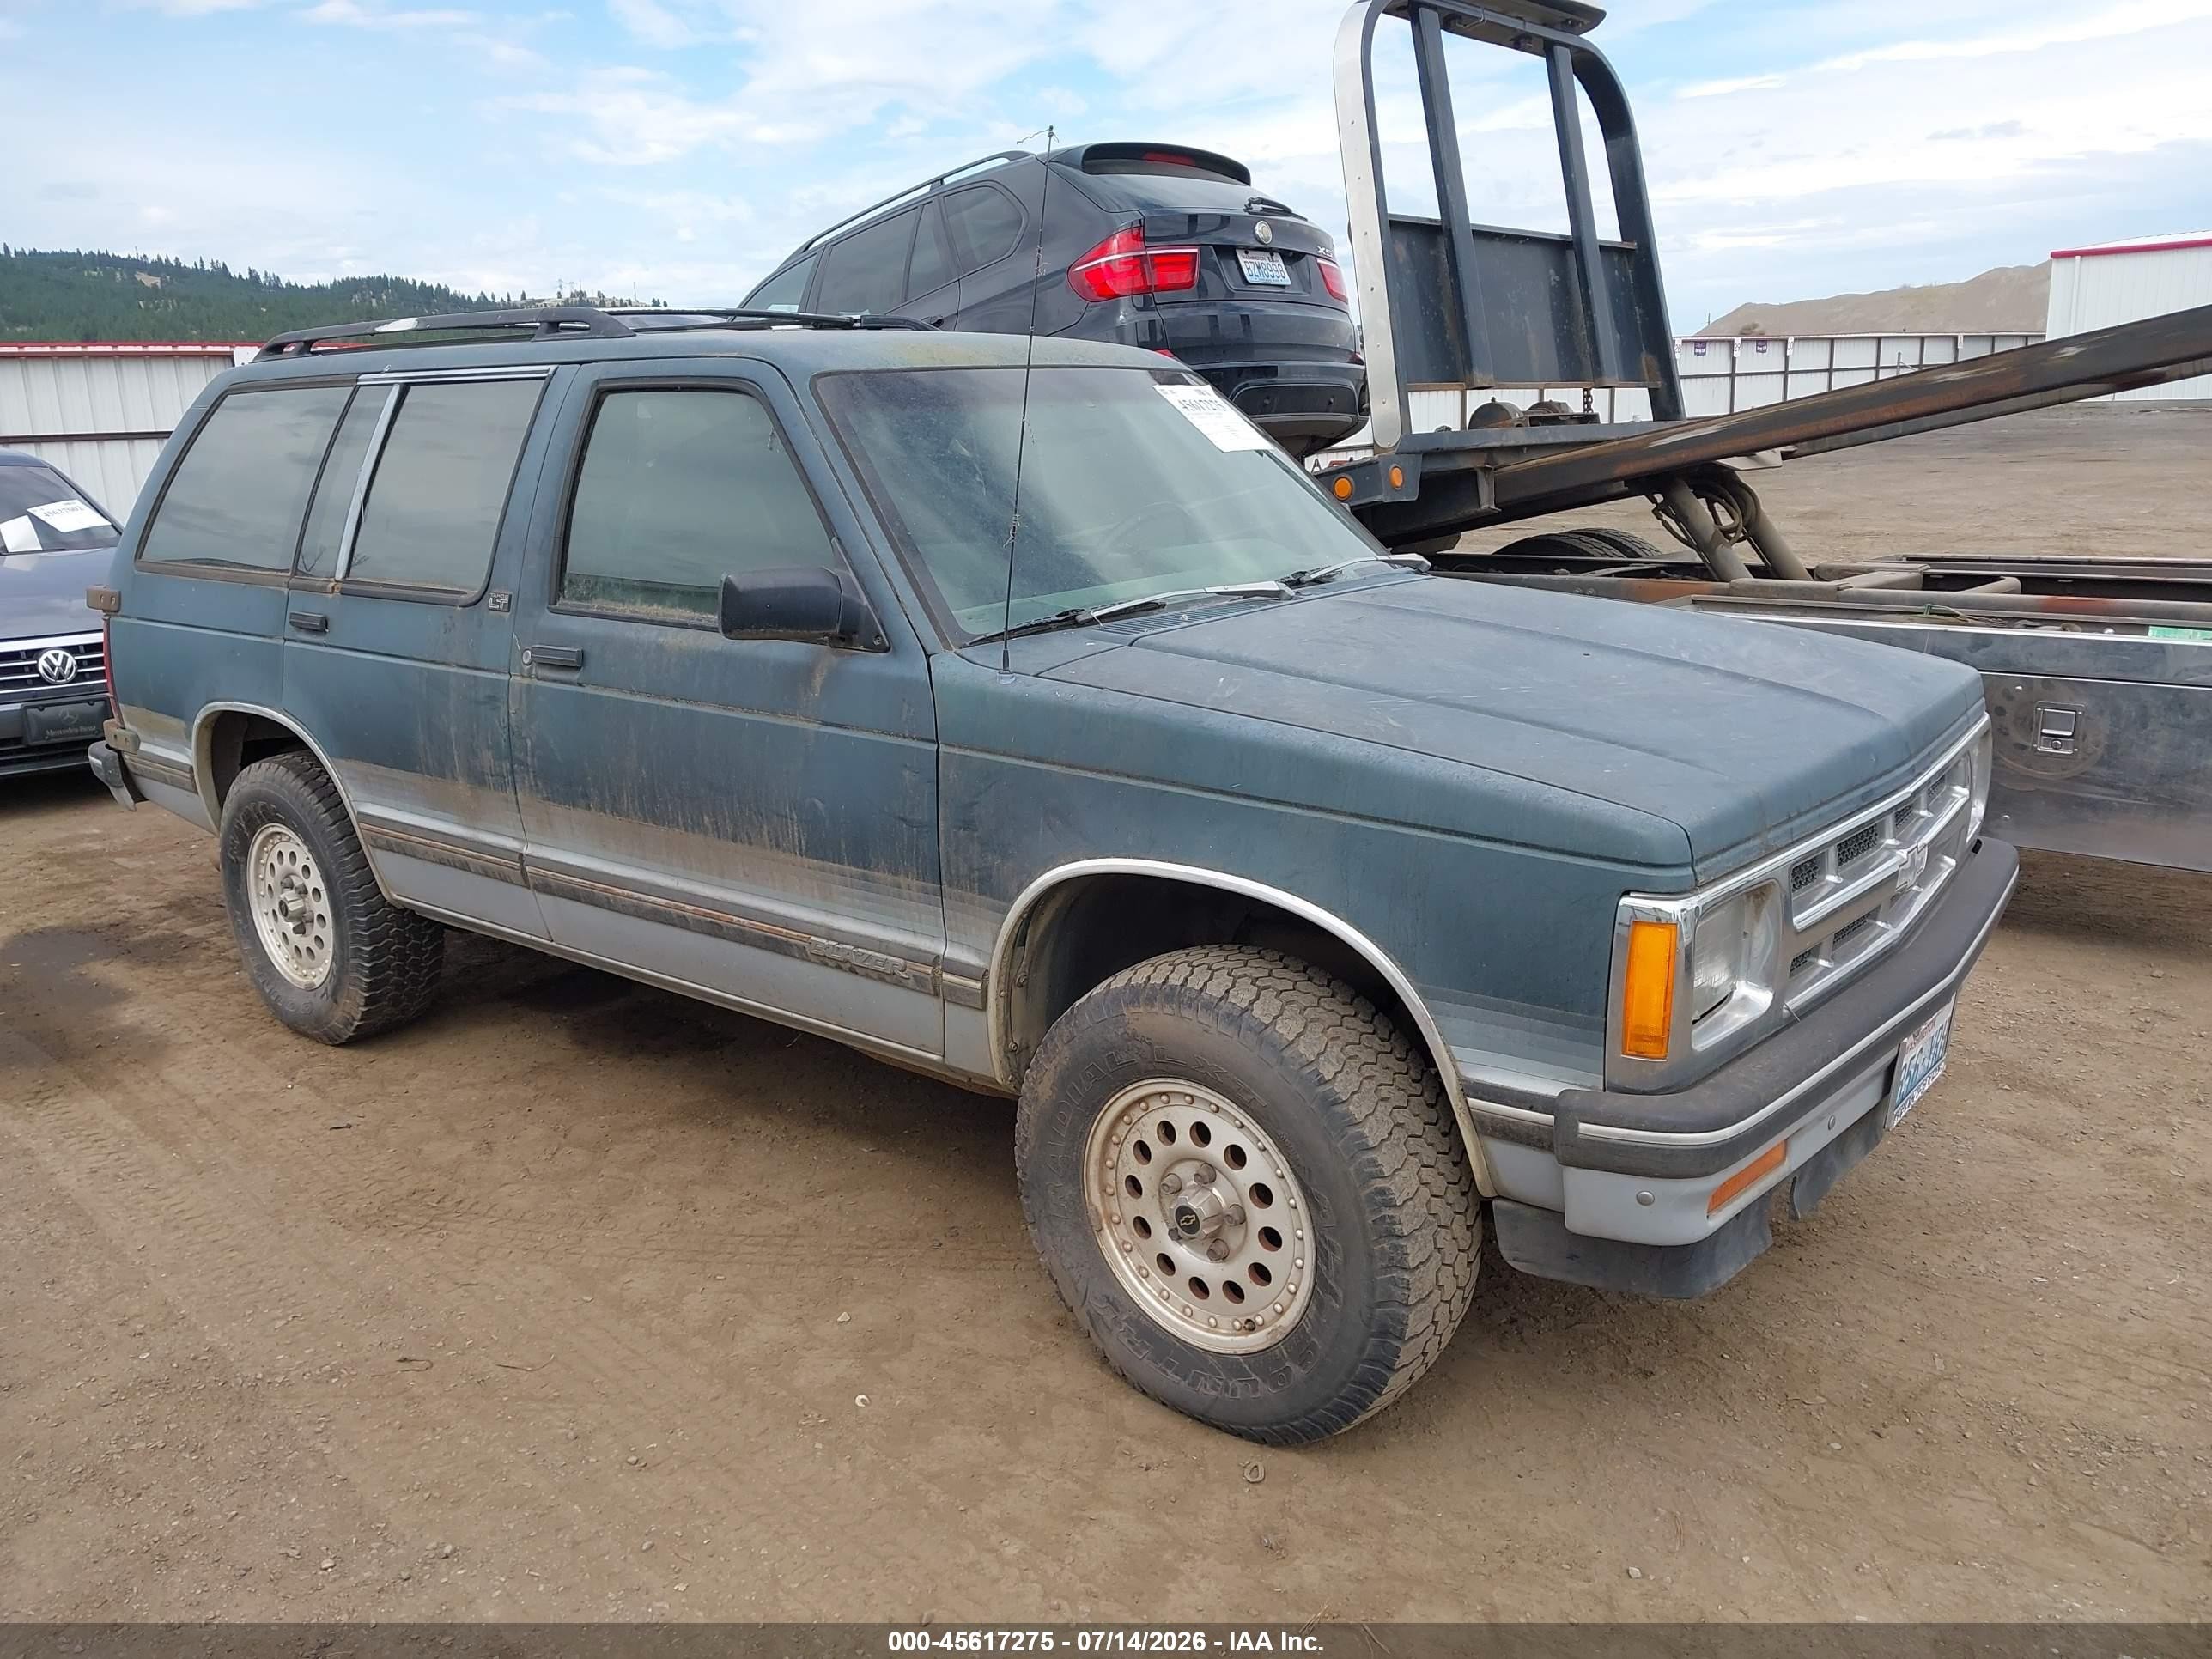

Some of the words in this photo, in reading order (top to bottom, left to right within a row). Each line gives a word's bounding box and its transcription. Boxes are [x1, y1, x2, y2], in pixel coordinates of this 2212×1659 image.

[1316, 246, 1333, 258] X5
[489, 597, 508, 610] LT
[808, 936, 910, 980] BLAZER
